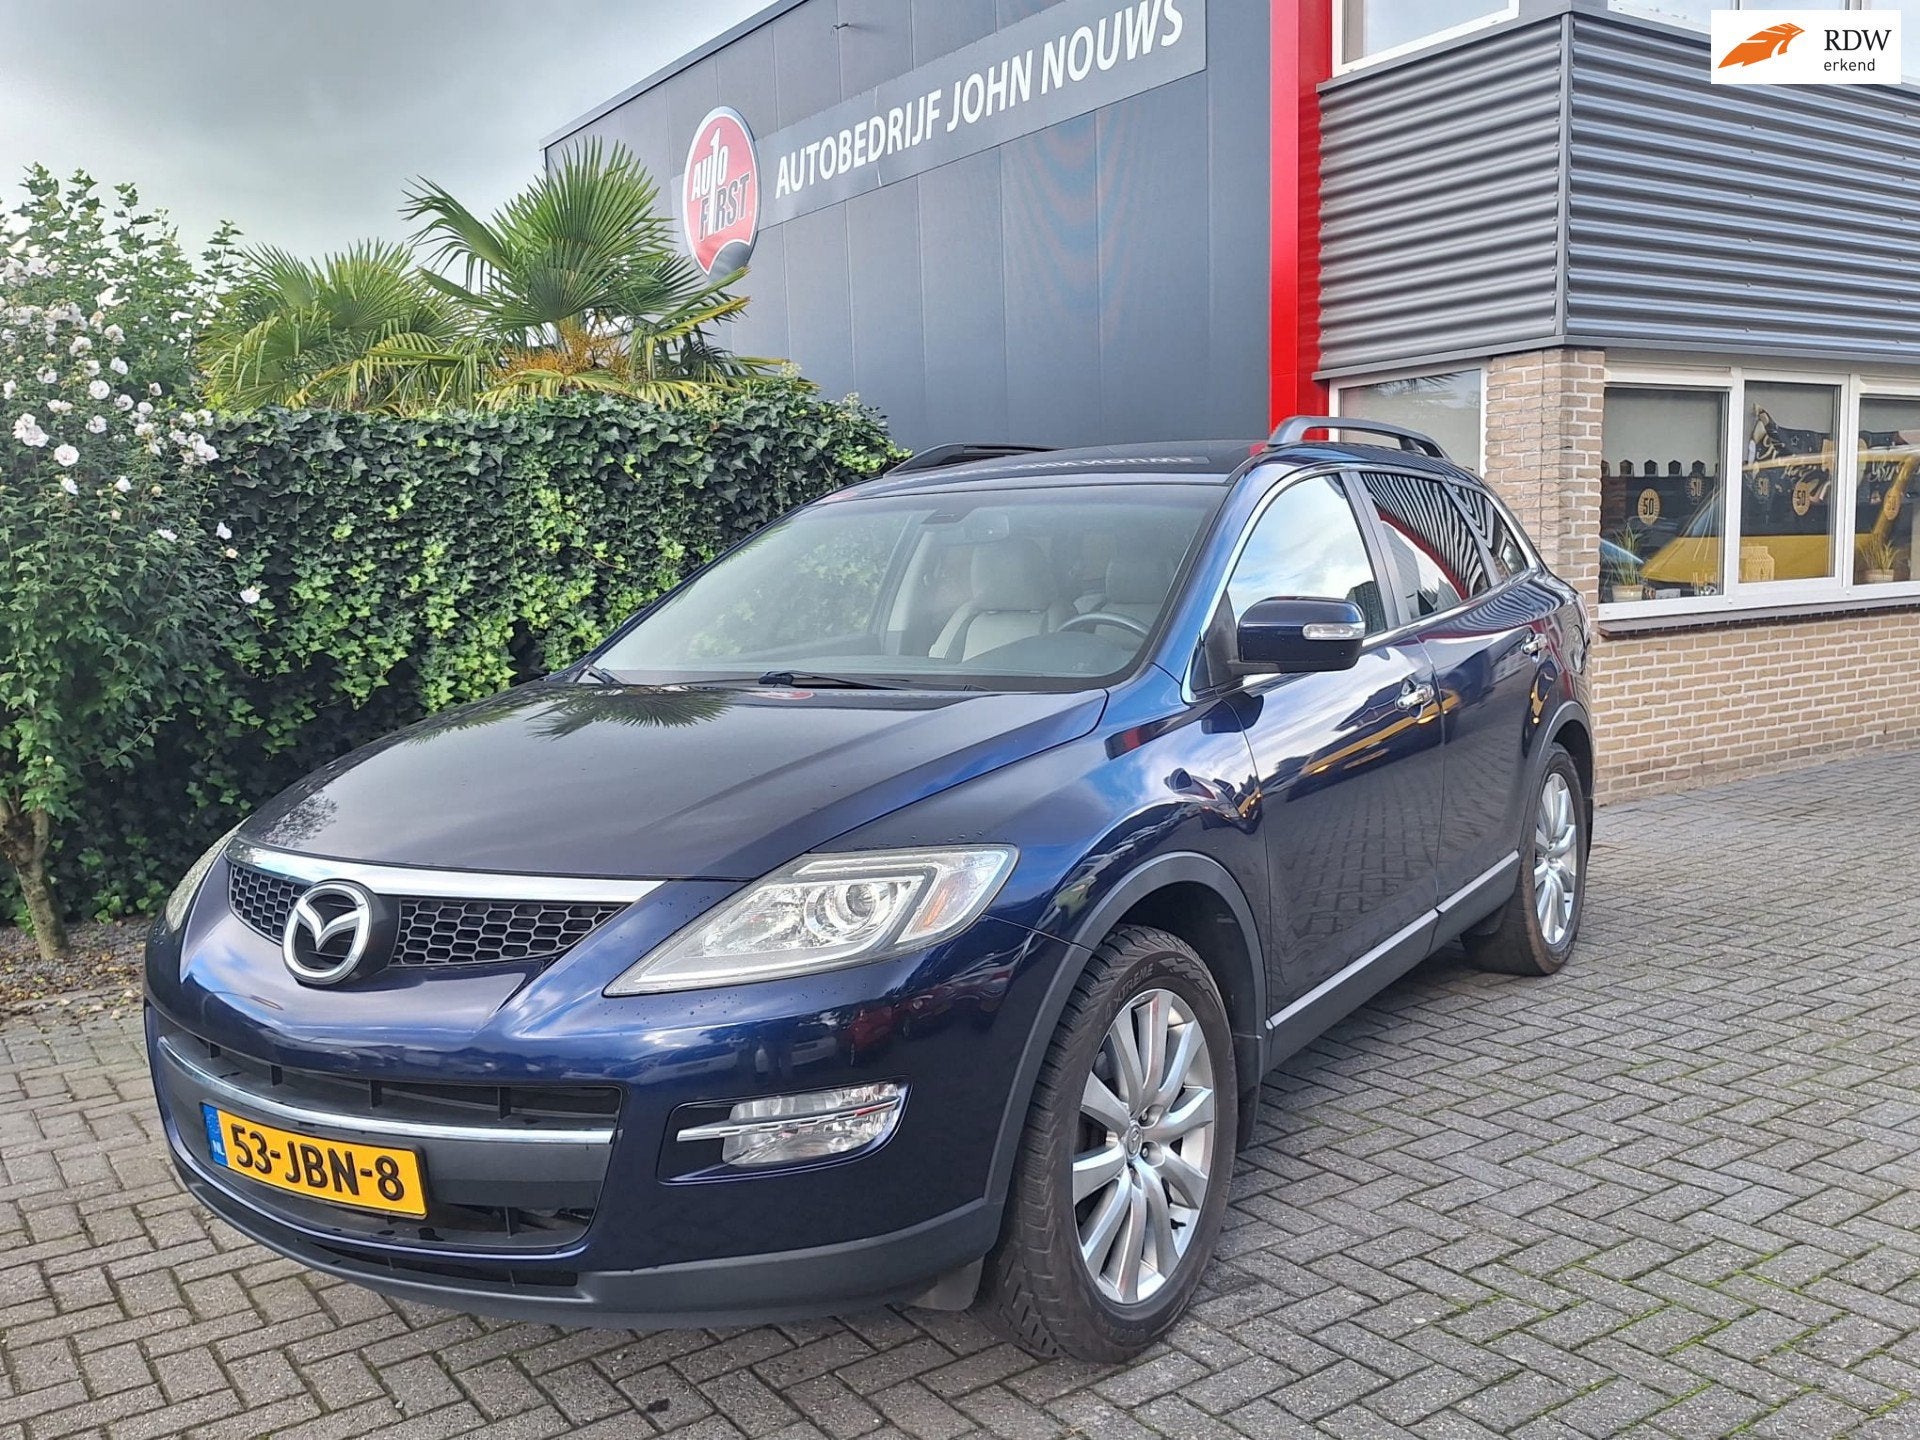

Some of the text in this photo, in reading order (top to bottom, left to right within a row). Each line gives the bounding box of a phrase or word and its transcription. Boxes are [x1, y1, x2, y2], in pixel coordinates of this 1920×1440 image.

[775, 0, 1183, 199] AUTOBEDRIJF JOHN NOUWS
[1642, 498, 1655, 515] 50
[212, 1139, 225, 1156] NL
[231, 1123, 405, 1201] 53-JBN-8
